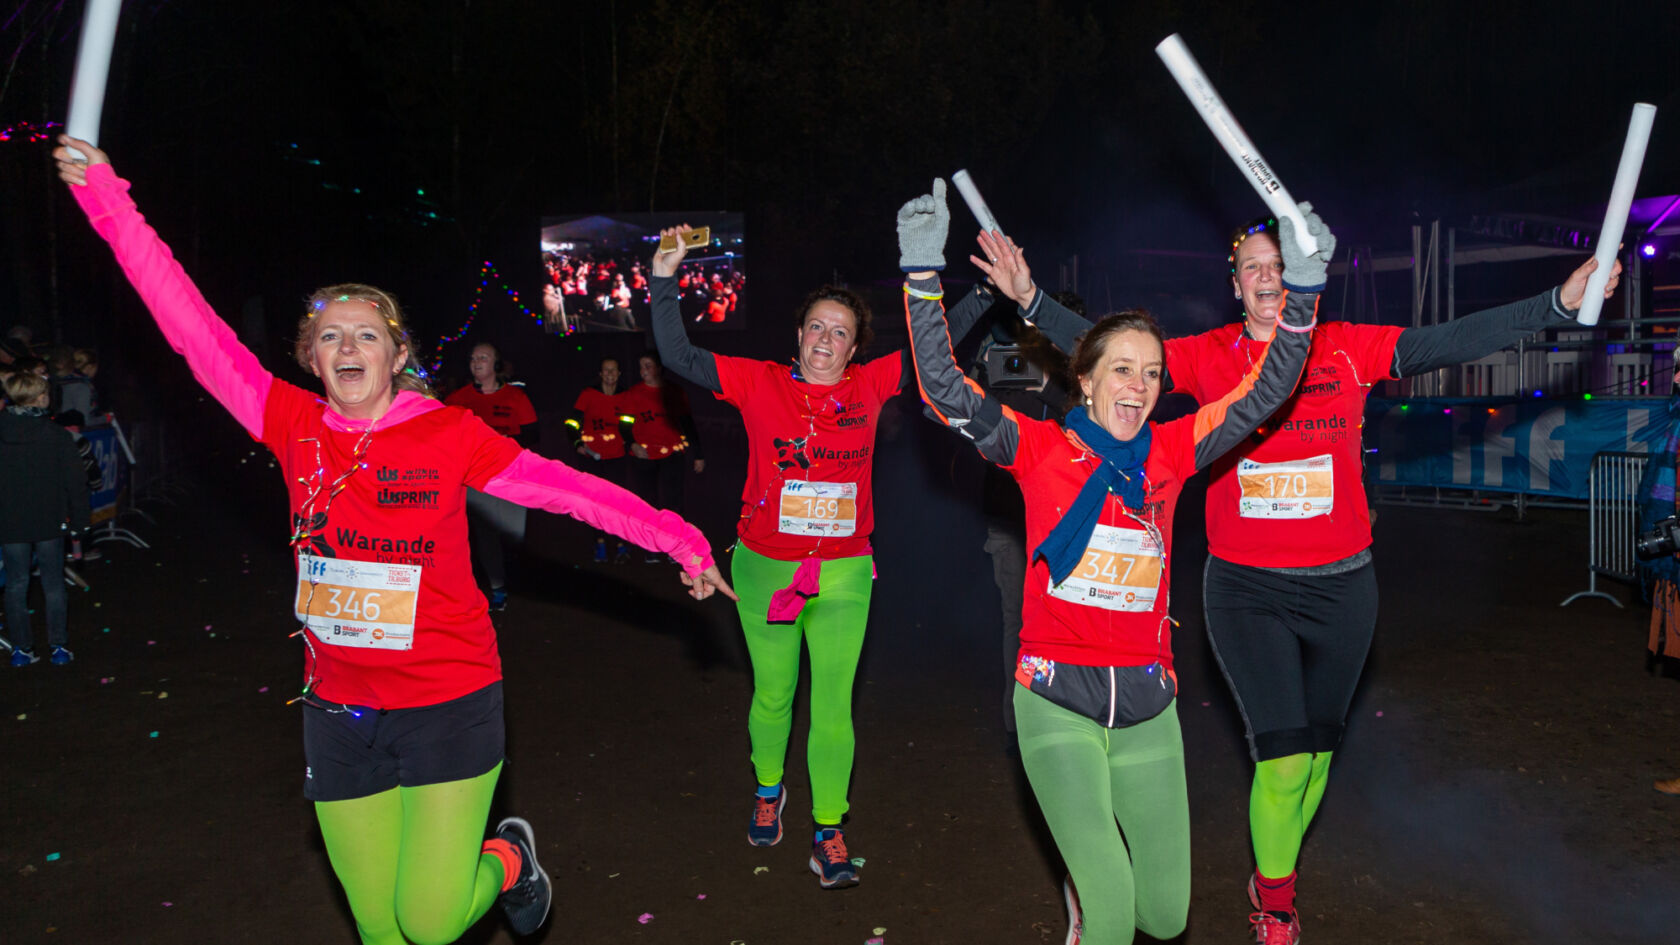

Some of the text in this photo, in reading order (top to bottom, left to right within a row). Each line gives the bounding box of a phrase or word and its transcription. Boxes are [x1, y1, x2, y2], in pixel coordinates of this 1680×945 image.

[1265, 414, 1347, 432] Warande
[1300, 430, 1348, 443] by night
[812, 444, 870, 460] Warande
[1451, 405, 1567, 491] iff
[787, 482, 804, 492] iff
[1264, 474, 1307, 497] 170
[803, 498, 839, 519] 169
[336, 527, 436, 554] Warande
[307, 559, 326, 577] iff
[376, 552, 436, 568] by night
[1082, 550, 1136, 585] 347
[1089, 587, 1097, 597] B
[1097, 588, 1122, 597] BRABANT
[325, 587, 382, 621] 346
[333, 625, 341, 636] B
[342, 625, 368, 634] BRABANT
[342, 630, 360, 638] SPORT
